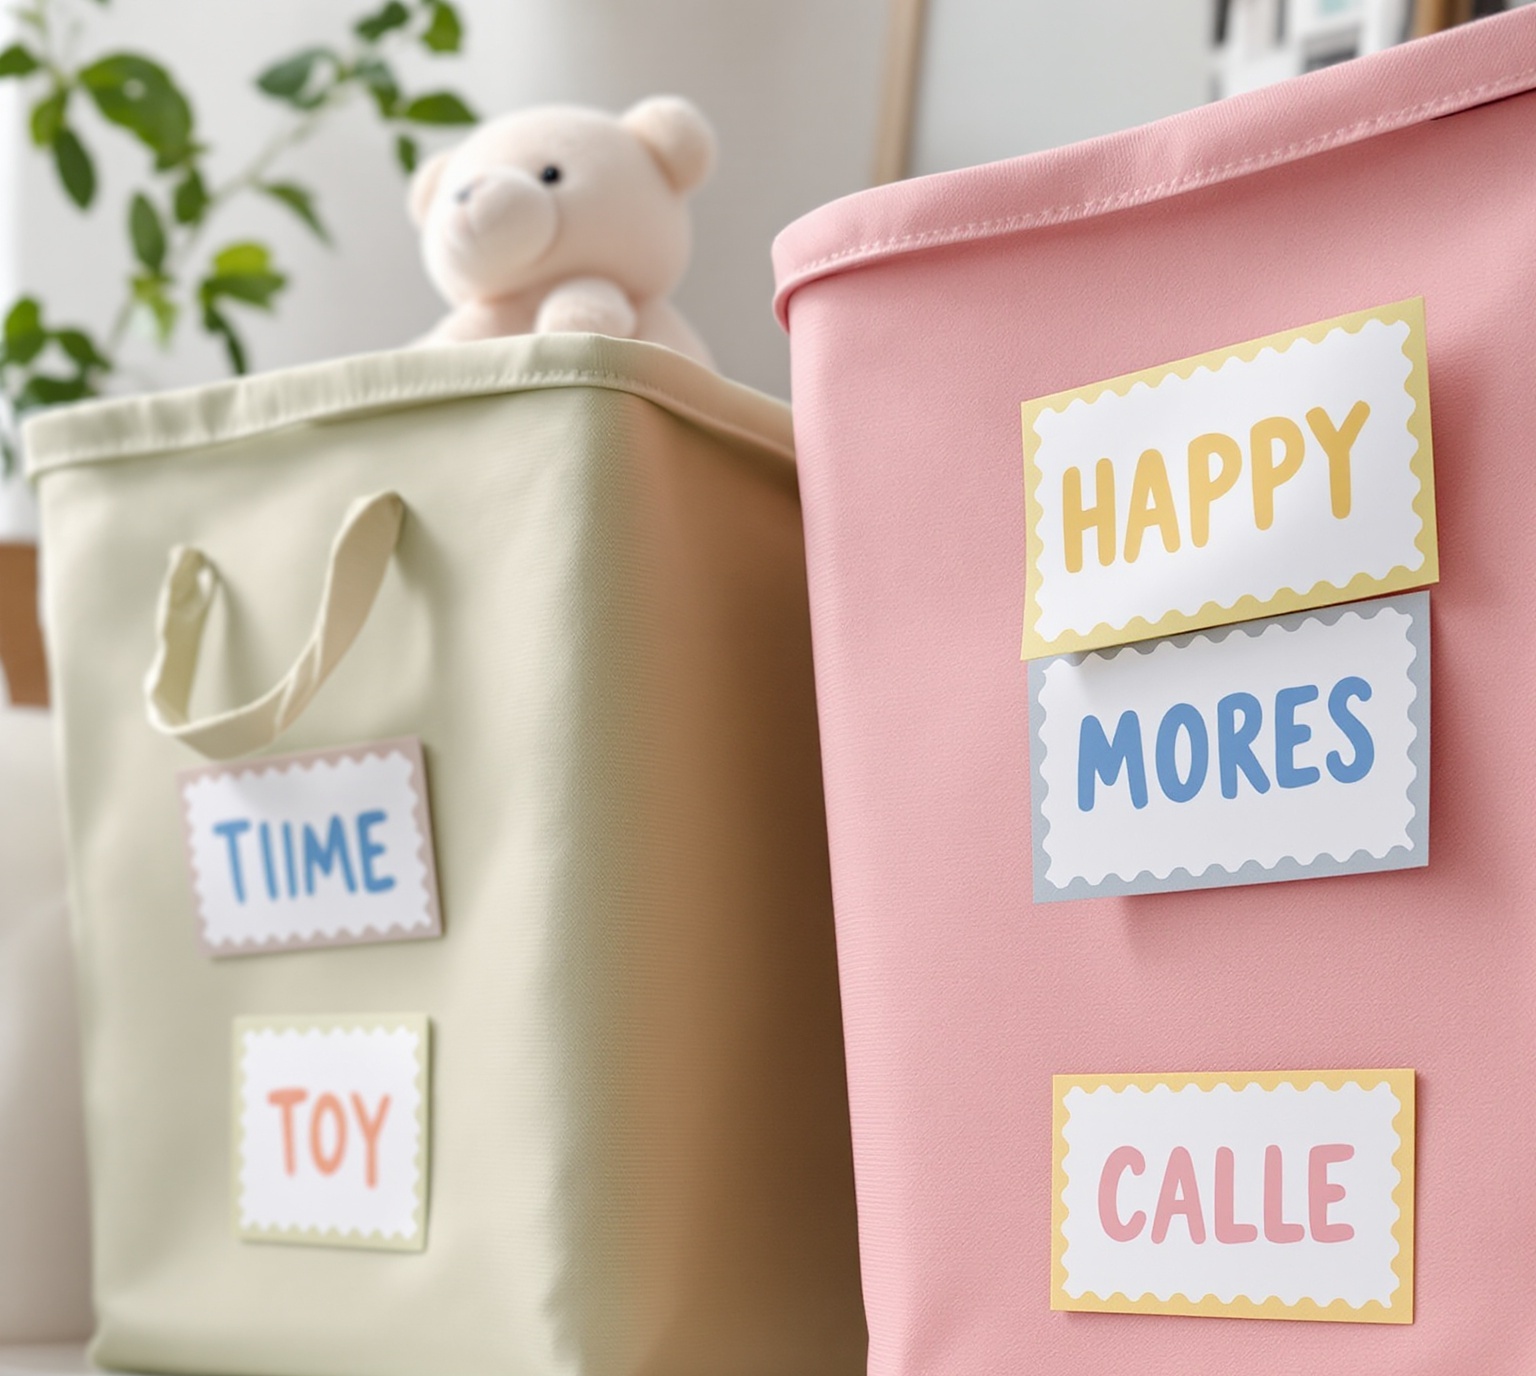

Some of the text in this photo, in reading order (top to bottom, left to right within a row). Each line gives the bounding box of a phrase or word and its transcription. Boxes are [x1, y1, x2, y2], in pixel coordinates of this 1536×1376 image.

[1062, 400, 1371, 573] HAPPY
[1077, 676, 1375, 811] MORES
[267, 1087, 392, 1190] TOY
[1098, 1144, 1355, 1245] CALLE
